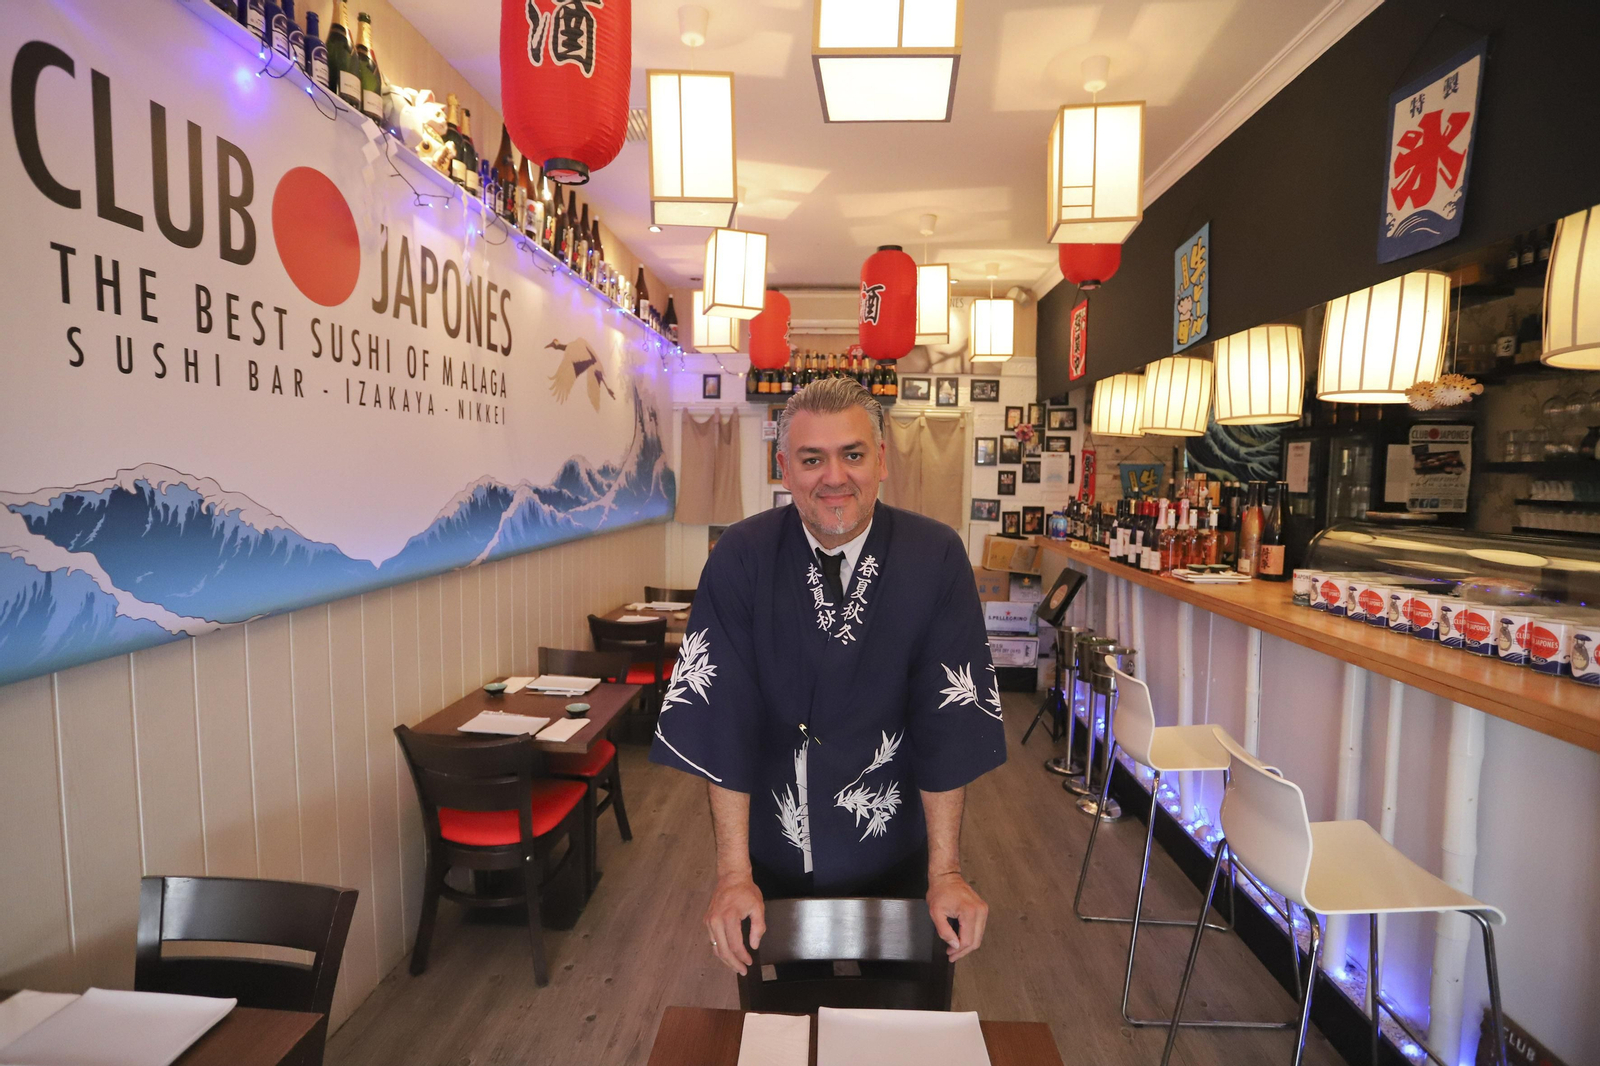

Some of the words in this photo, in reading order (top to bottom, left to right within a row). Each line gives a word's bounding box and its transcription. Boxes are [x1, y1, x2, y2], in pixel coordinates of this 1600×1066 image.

[11, 40, 256, 266] CLUB
[371, 223, 512, 357] JAPONES
[50, 240, 159, 324] THE
[195, 283, 288, 352] BEST
[310, 317, 391, 374] SUSHI
[407, 345, 429, 381] OF
[442, 355, 507, 399] MALAGA
[66, 326, 221, 387] SUSHI
[248, 359, 304, 399] BAR
[346, 377, 434, 416] IZAKAYA
[458, 399, 505, 425] NIKKEI
[1411, 429, 1428, 439] CLUB
[1439, 430, 1470, 439] JAPONES
[806, 563, 836, 642] 春夏秋
[833, 554, 879, 645] 春夏秋冬
[1516, 632, 1531, 640] CLUB
[1535, 638, 1559, 649] JAPONES
